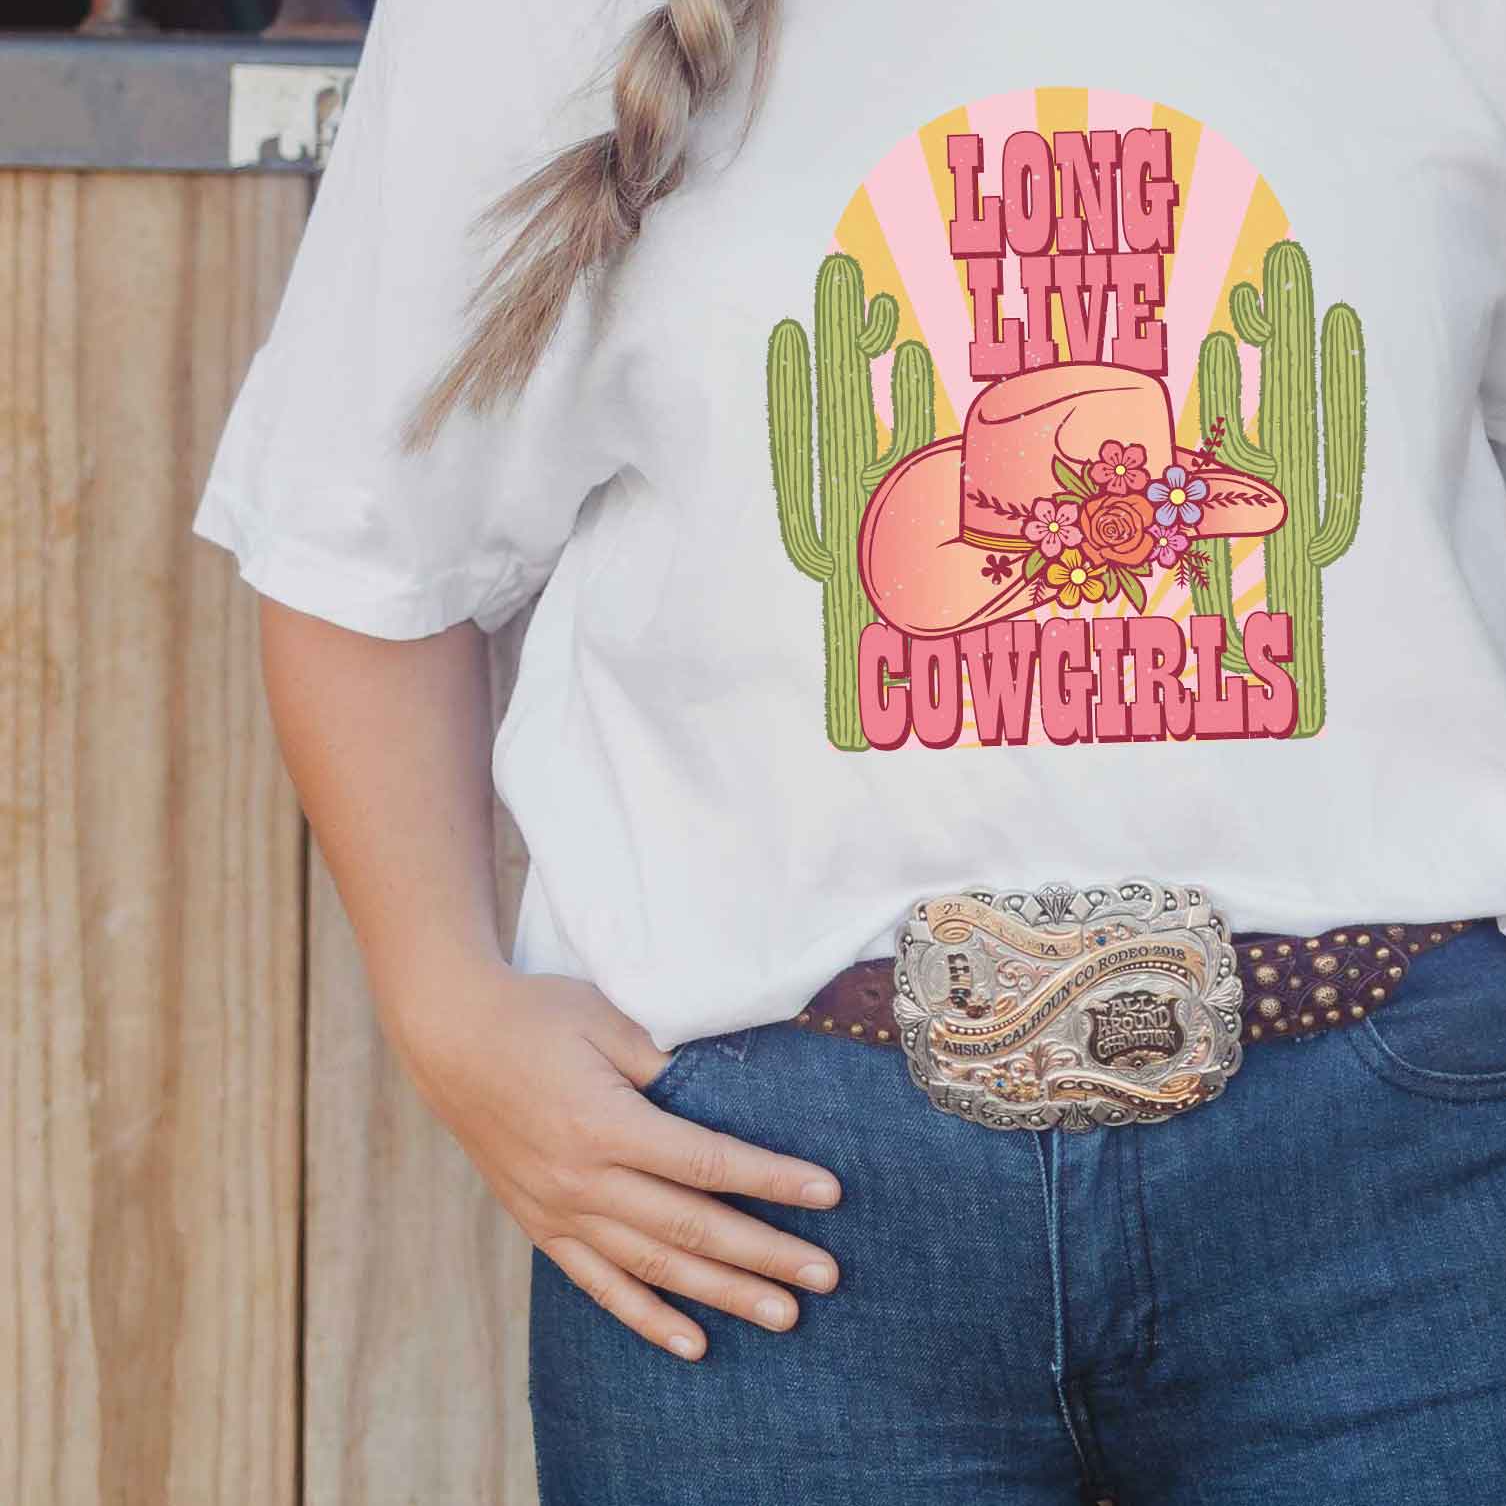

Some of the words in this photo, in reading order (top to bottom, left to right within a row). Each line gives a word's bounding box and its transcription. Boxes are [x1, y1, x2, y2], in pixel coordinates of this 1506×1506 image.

[947, 128, 1179, 257] LONG
[967, 252, 1167, 381] LIVE
[858, 611, 1298, 751] COWGIRLS
[1098, 946, 1148, 972] RODEO
[1153, 945, 1186, 960] 2018
[1109, 995, 1155, 1015] ALL
[1096, 1006, 1171, 1040] AROUND
[1096, 1030, 1176, 1059] CHAMPION
